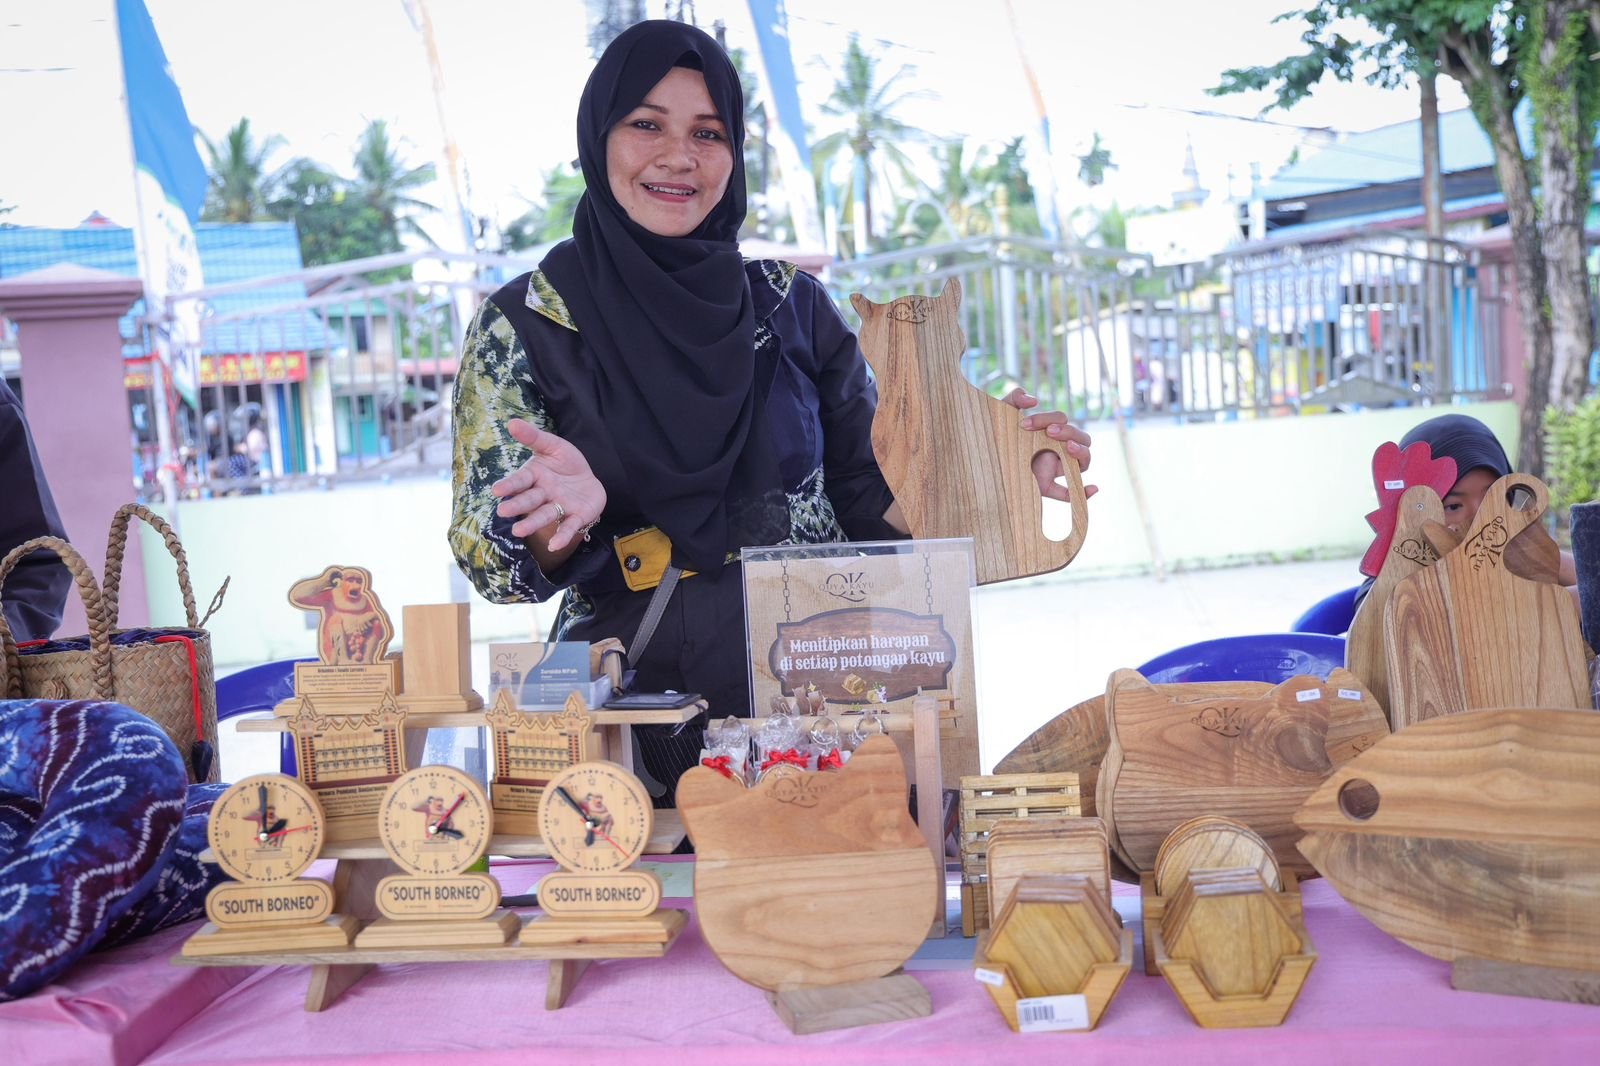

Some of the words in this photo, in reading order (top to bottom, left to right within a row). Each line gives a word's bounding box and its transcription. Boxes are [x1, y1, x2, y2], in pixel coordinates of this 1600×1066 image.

[1486, 515, 1504, 542] QUYA
[1392, 545, 1418, 556] QUYA
[818, 583, 845, 592] QUYA
[850, 581, 875, 590] KAYU
[789, 635, 868, 653] Menitipkan
[870, 633, 930, 650] harapan
[780, 656, 793, 671] di
[795, 656, 838, 671] setiap
[840, 652, 907, 670] potongan
[910, 649, 946, 667] kayu
